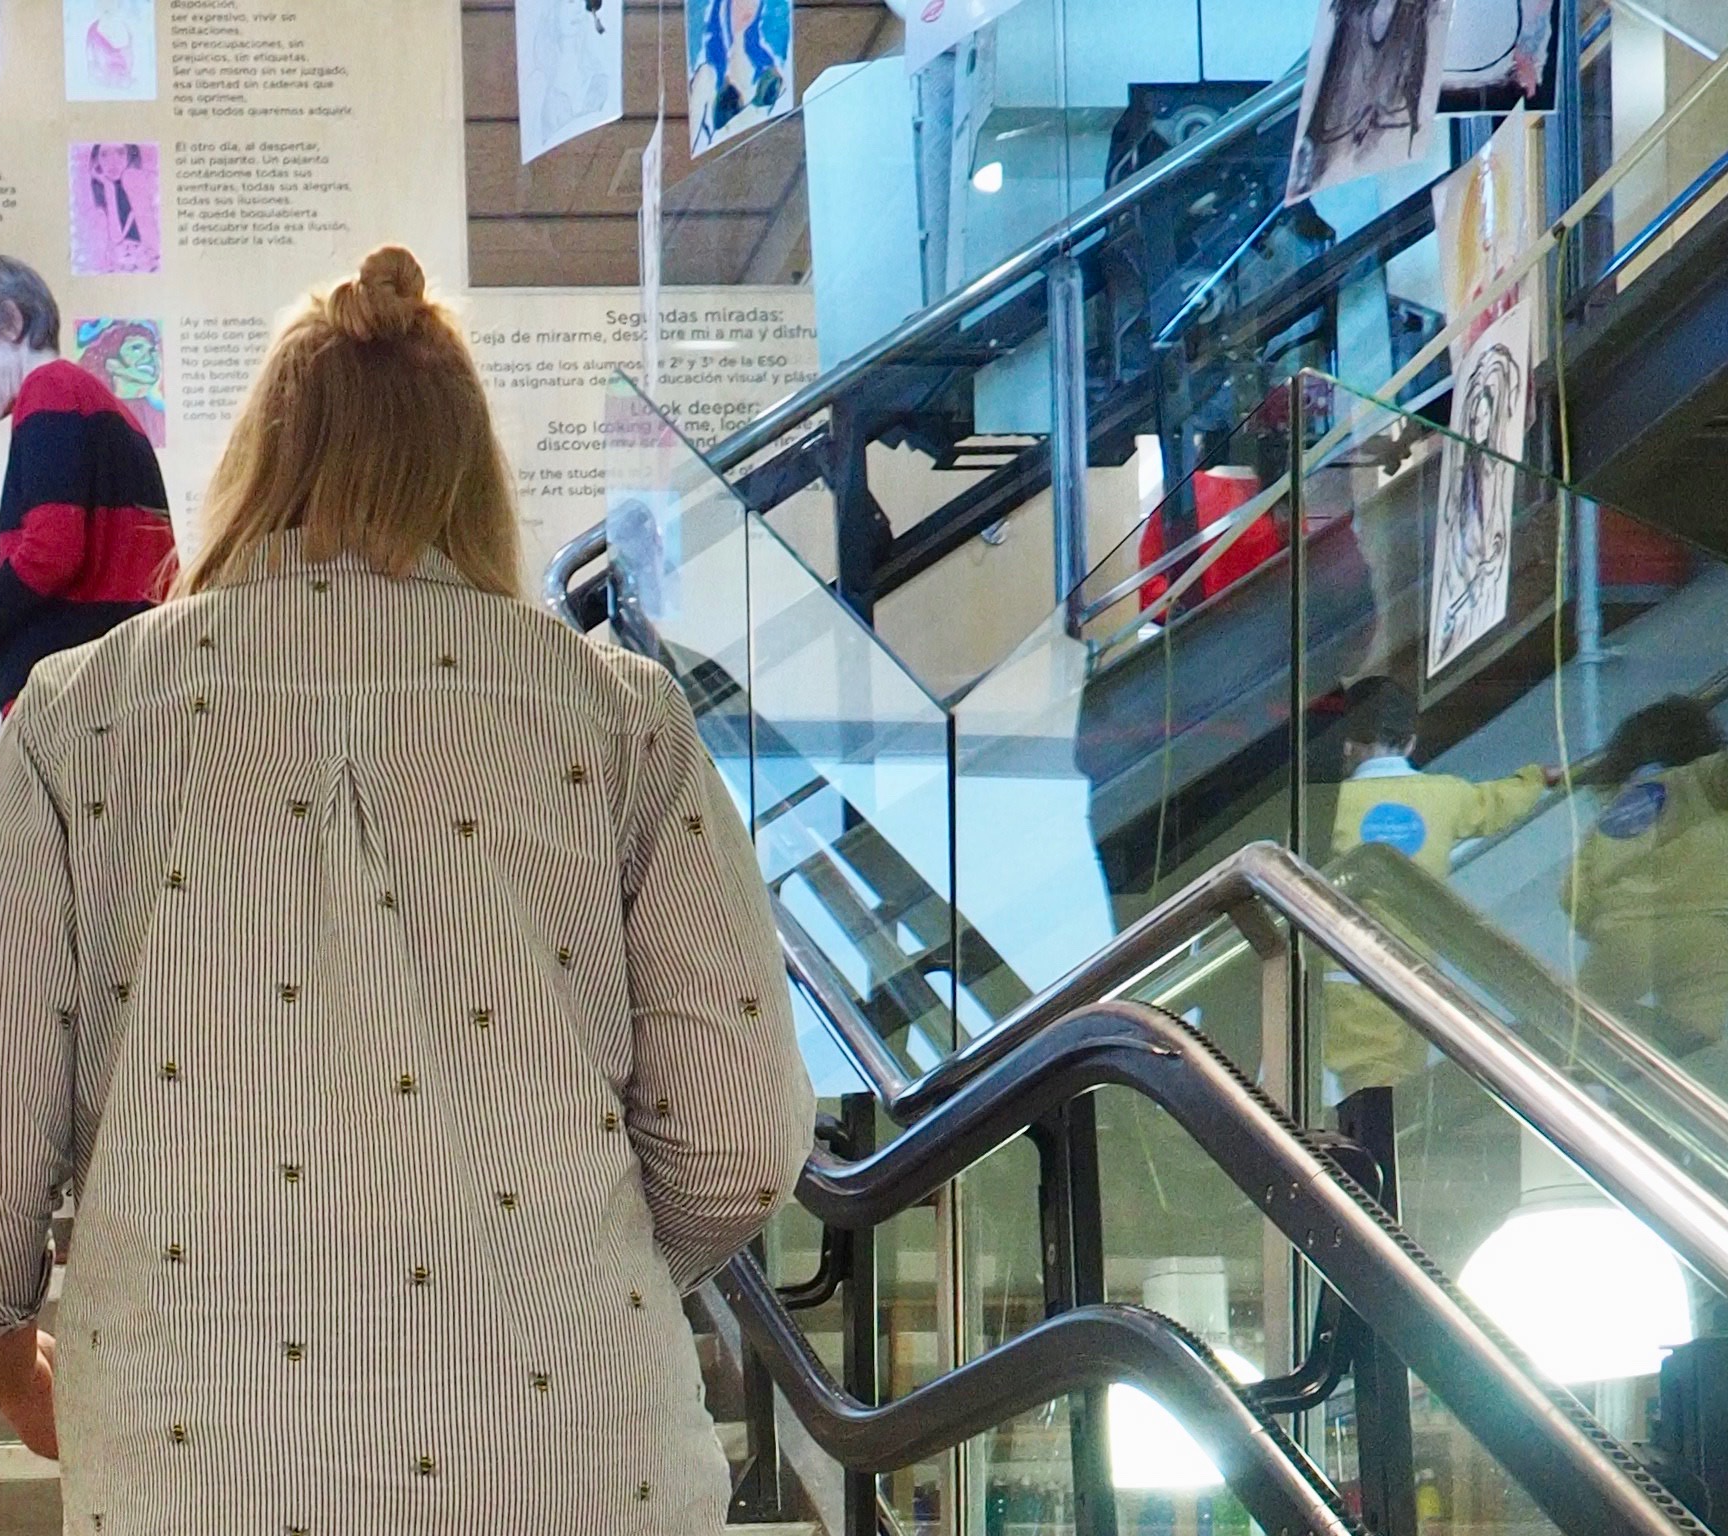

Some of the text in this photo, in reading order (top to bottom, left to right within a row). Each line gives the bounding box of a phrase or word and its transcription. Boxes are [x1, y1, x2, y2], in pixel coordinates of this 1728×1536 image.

[704, 307, 784, 323] miradas:
[511, 328, 530, 343] de
[773, 324, 818, 339] disfru
[548, 420, 587, 434] Stop
